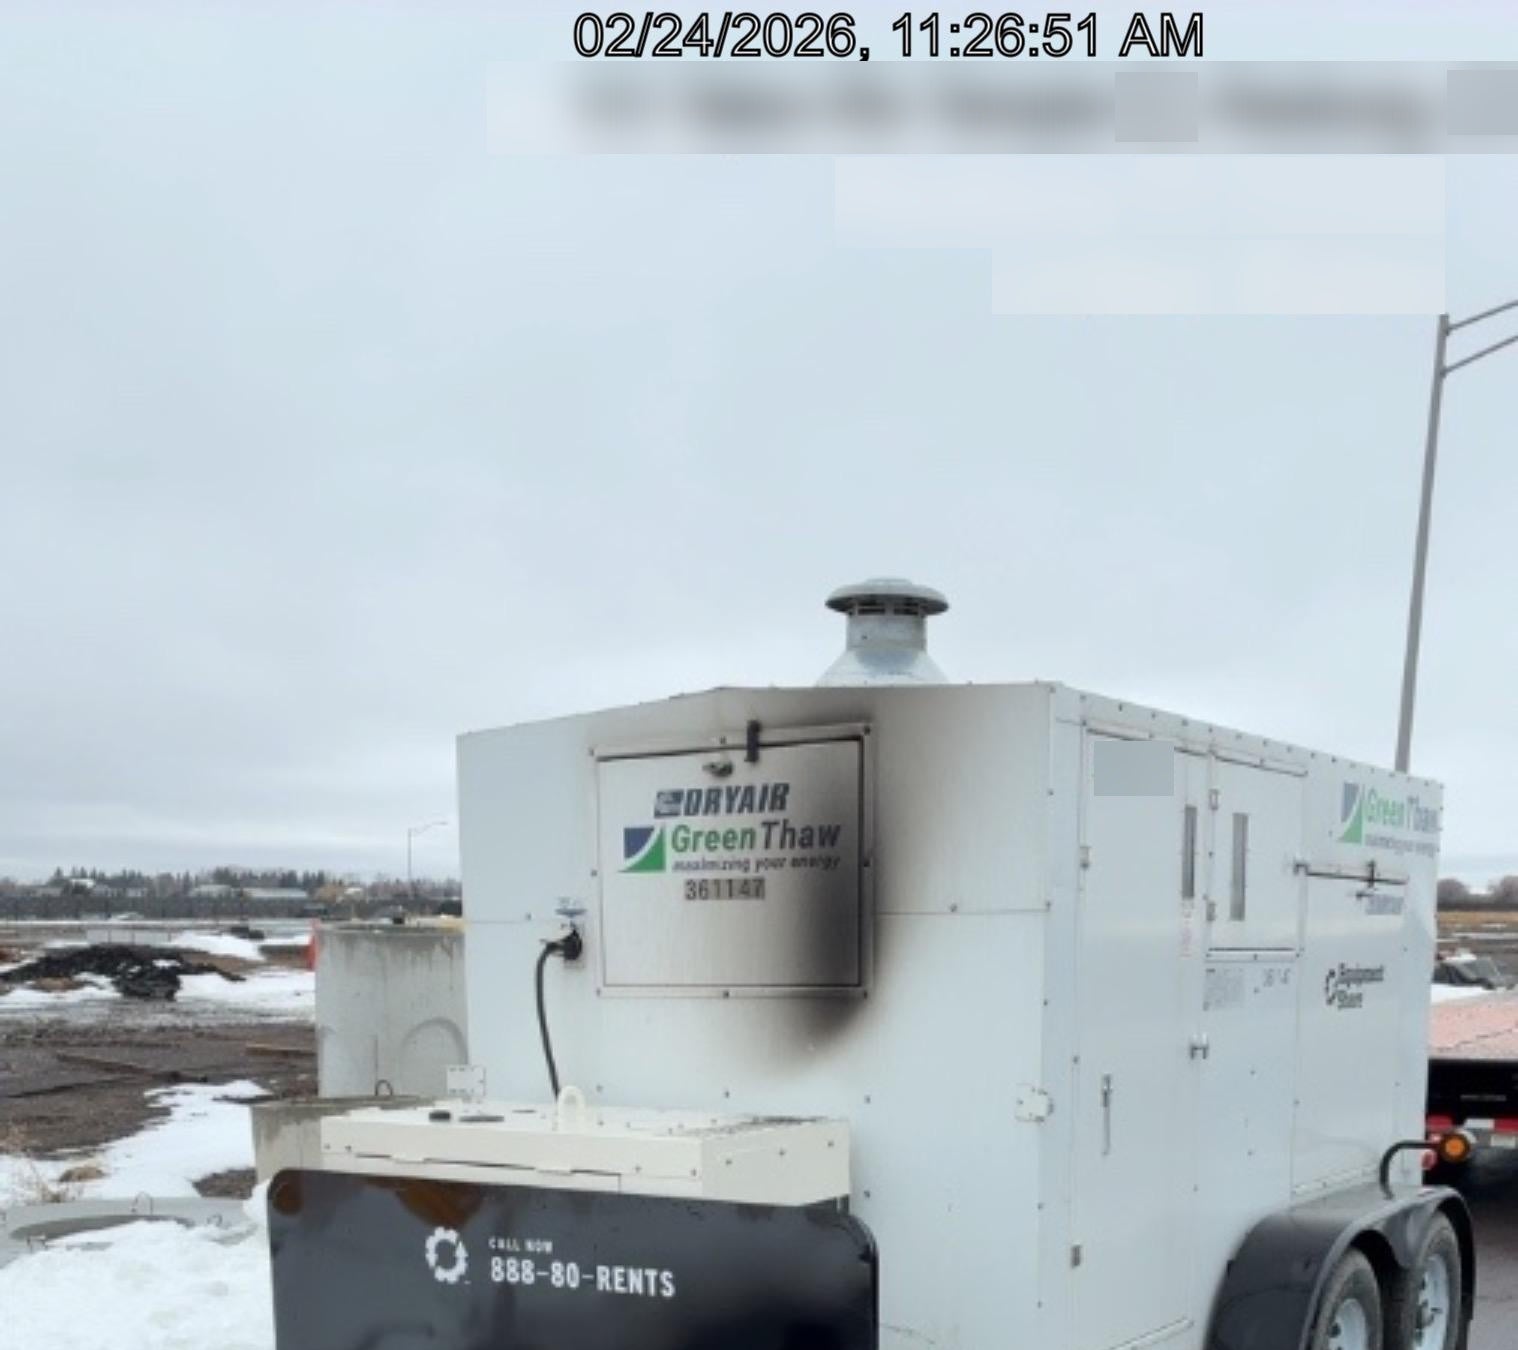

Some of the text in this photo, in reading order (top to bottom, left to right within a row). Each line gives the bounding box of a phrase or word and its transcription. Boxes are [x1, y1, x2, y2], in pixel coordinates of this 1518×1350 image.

[683, 783, 790, 817] DRYAIR
[753, 856, 788, 873] your
[790, 855, 841, 871] energy
[684, 877, 766, 901] 361147
[488, 1236, 554, 1255] CALL NOW
[490, 1255, 677, 1299] 888-80-RENTS
